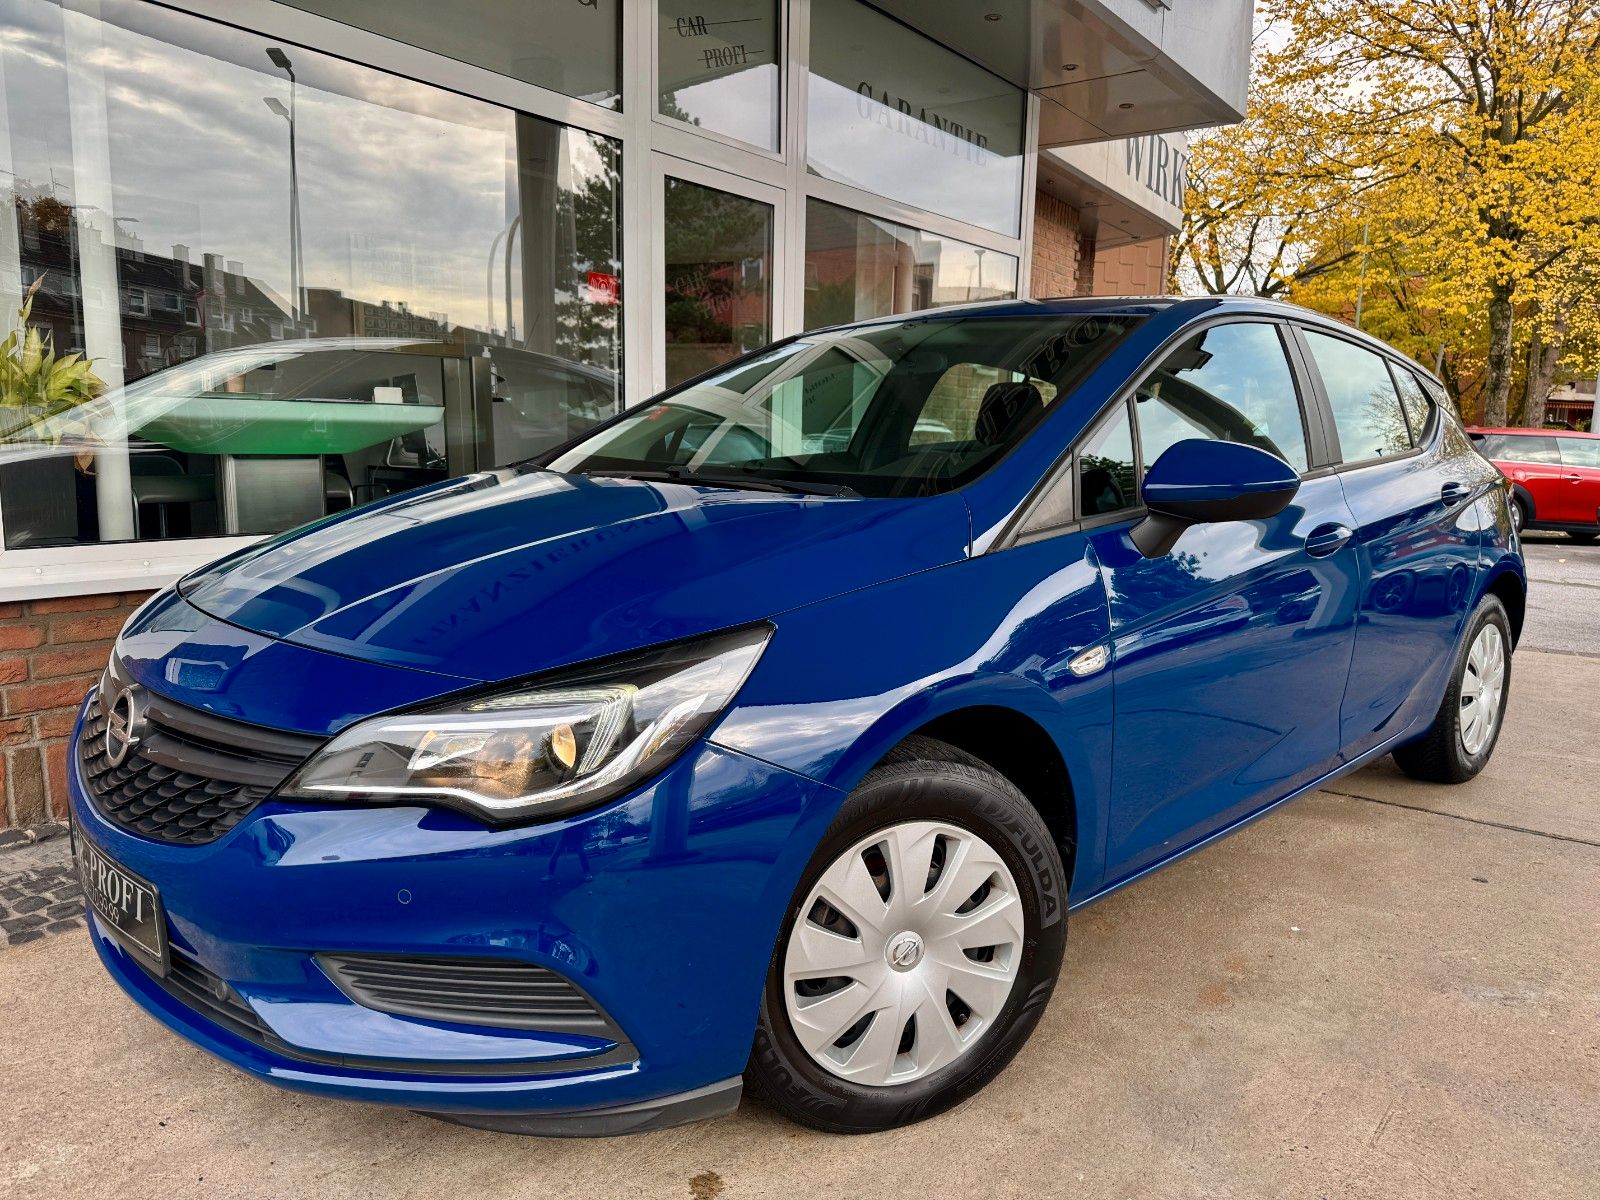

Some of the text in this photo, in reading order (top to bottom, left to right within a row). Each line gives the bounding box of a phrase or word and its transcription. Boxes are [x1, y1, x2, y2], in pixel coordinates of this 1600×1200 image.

[676, 16, 709, 38] CAR
[703, 45, 748, 69] PROFI
[857, 81, 988, 168] GARANTIE
[1126, 135, 1187, 211] WIRK
[1006, 821, 1057, 919] FULDA
